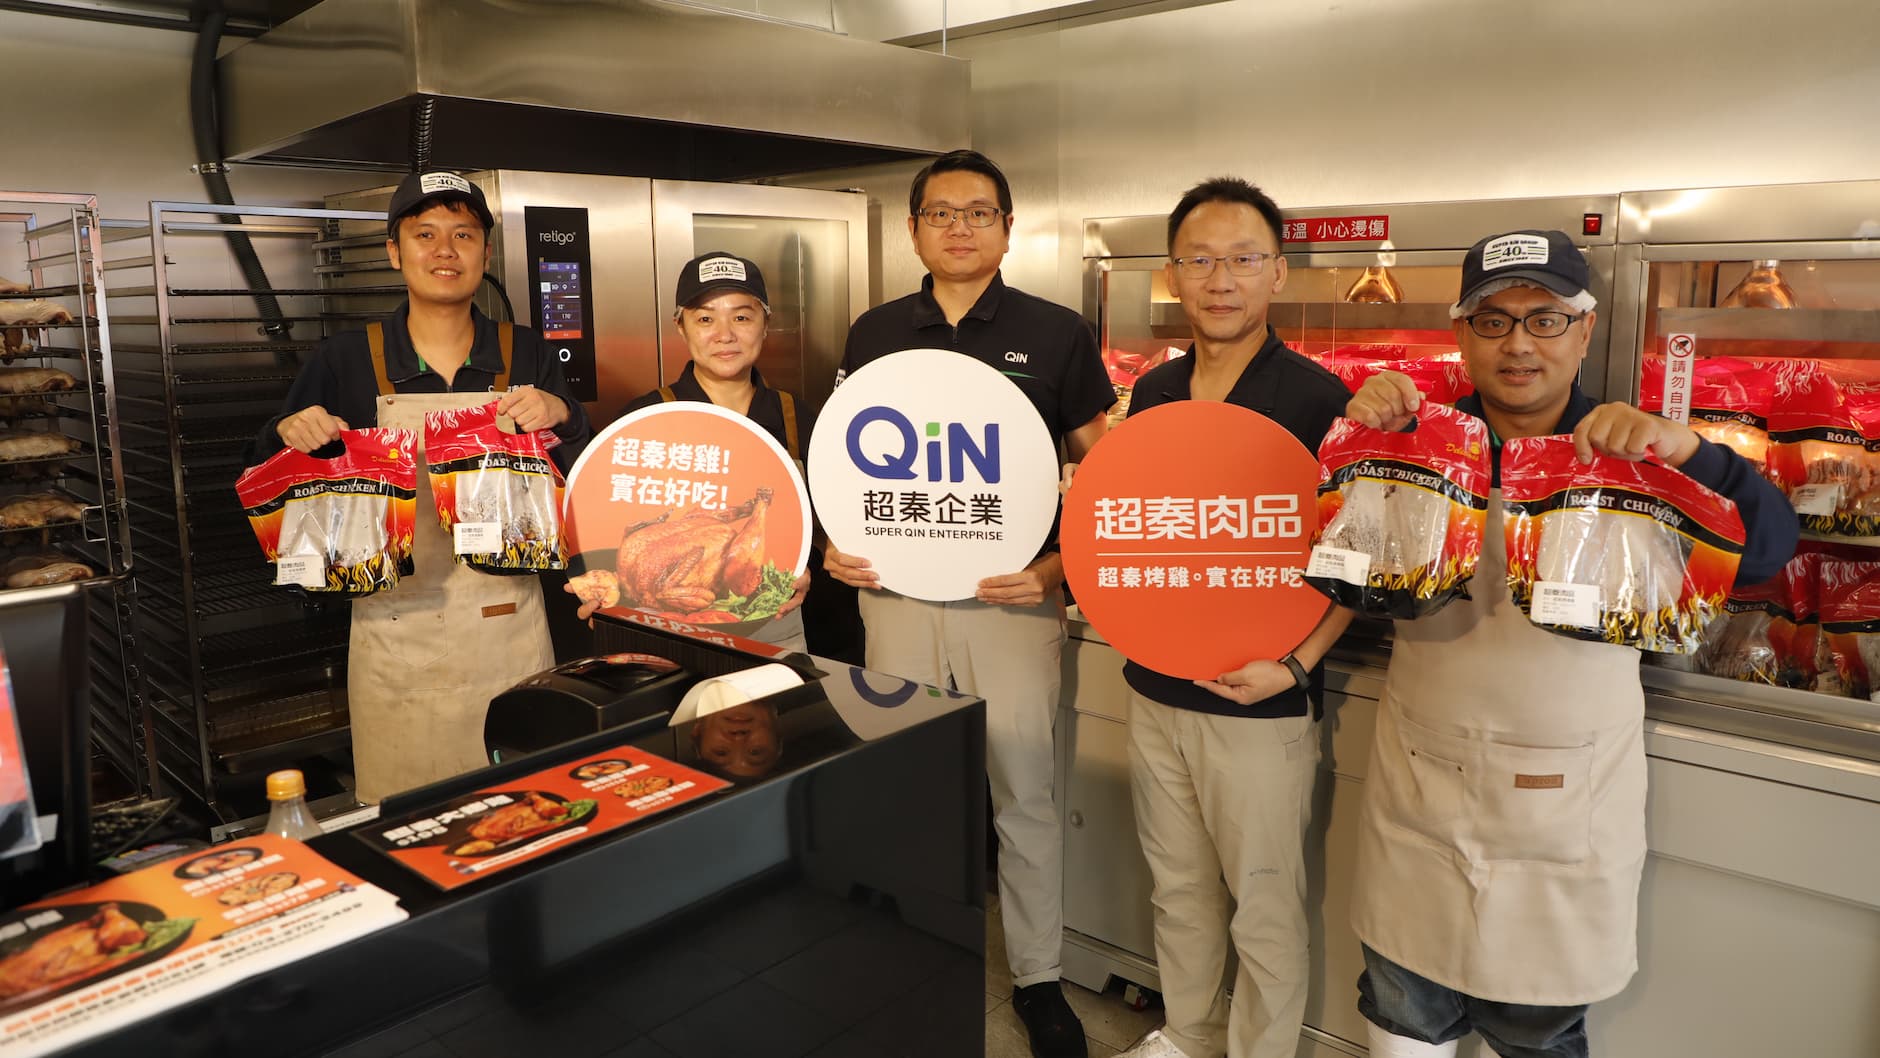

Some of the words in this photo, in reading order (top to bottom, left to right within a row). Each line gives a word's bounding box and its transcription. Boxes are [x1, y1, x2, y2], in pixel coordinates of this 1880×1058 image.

[1317, 219, 1385, 238] 小心燙傷
[1826, 431, 1866, 445] ROAST
[863, 490, 1003, 525] 超秦企業
[1094, 494, 1302, 540] 超秦肉品
[865, 526, 902, 537] SUPER
[904, 528, 926, 537] QIN
[929, 529, 1004, 541] ENTERPRISE
